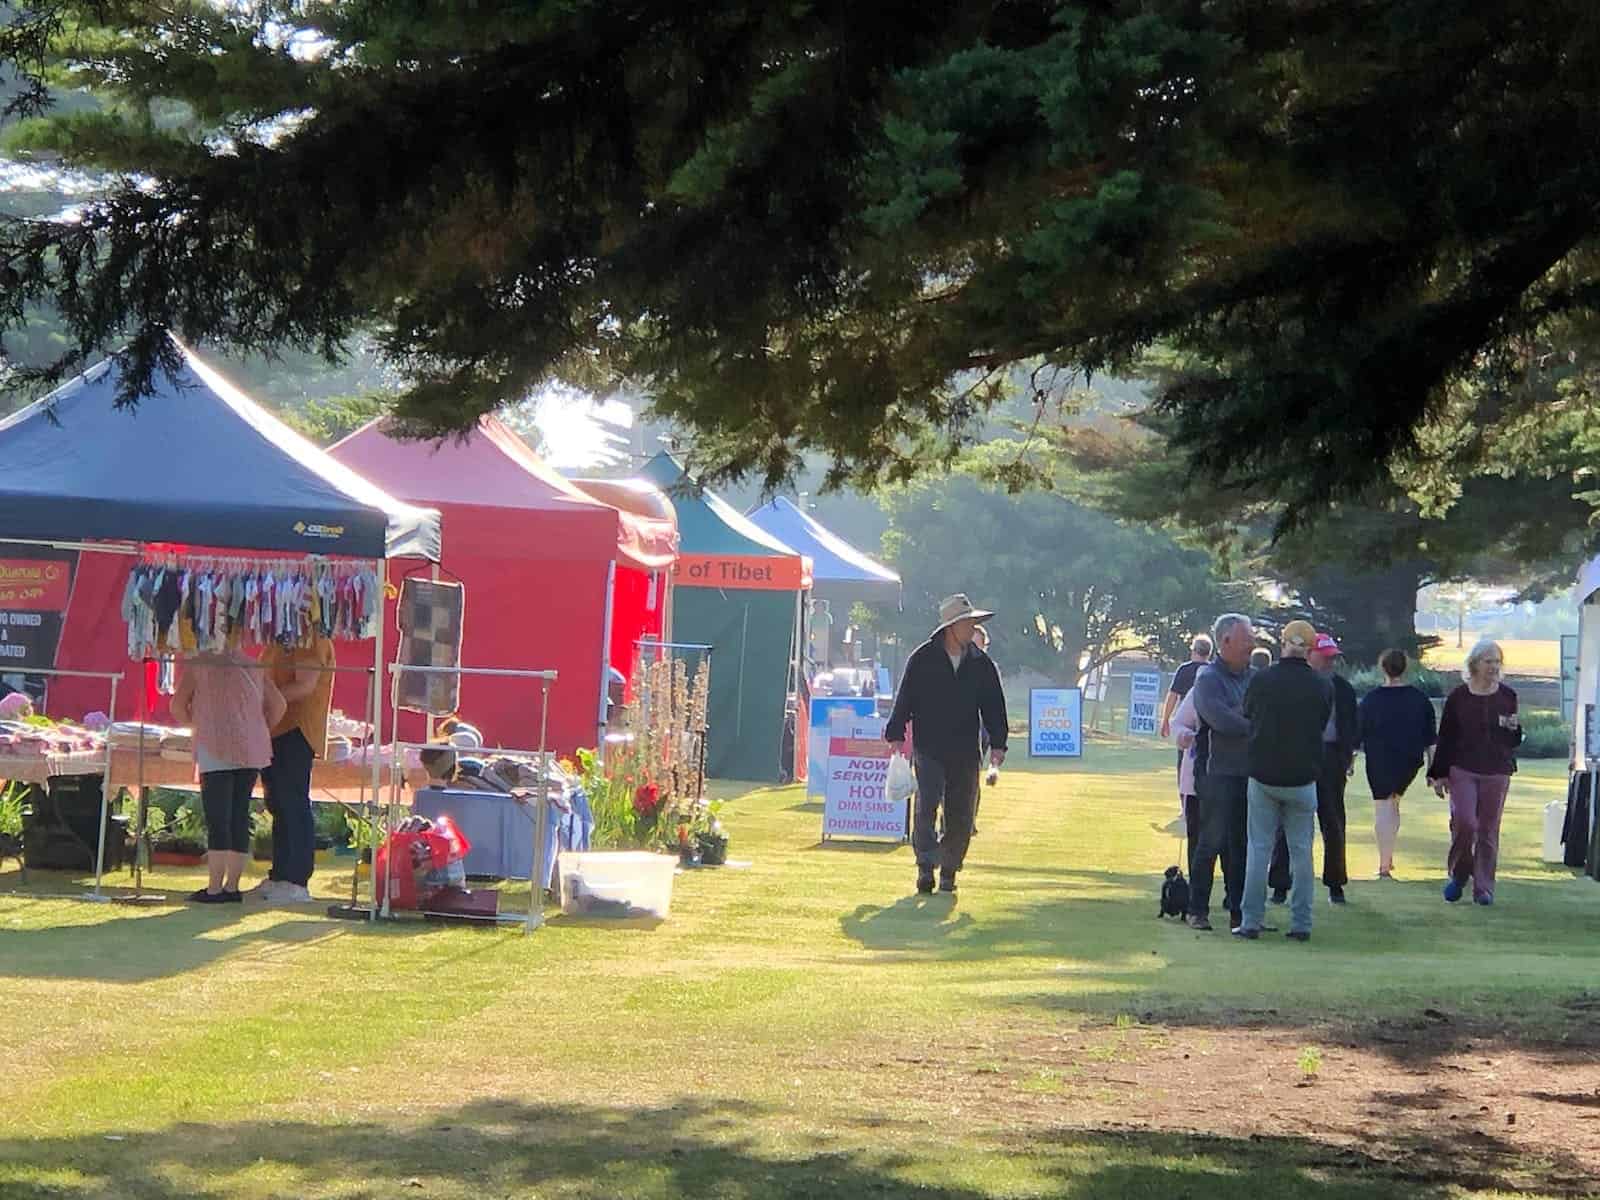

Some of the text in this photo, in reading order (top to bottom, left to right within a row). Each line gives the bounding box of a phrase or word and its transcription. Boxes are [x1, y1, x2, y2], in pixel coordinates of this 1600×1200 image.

[689, 561, 711, 578] of
[719, 561, 772, 581] Tibet
[9, 614, 41, 626] OWNED
[1041, 707, 1067, 717] HOT
[1133, 703, 1154, 716] NOW
[1038, 719, 1072, 729] FOOD
[1131, 717, 1154, 731] OPEN
[1040, 732, 1071, 741] COLD
[1035, 743, 1075, 752] DRINKS
[848, 760, 890, 770] NOW
[832, 771, 887, 782] SERVIN
[849, 785, 885, 799] HOT
[838, 800, 896, 813] DIM SIMS
[828, 818, 902, 832] DUMPLINGS
